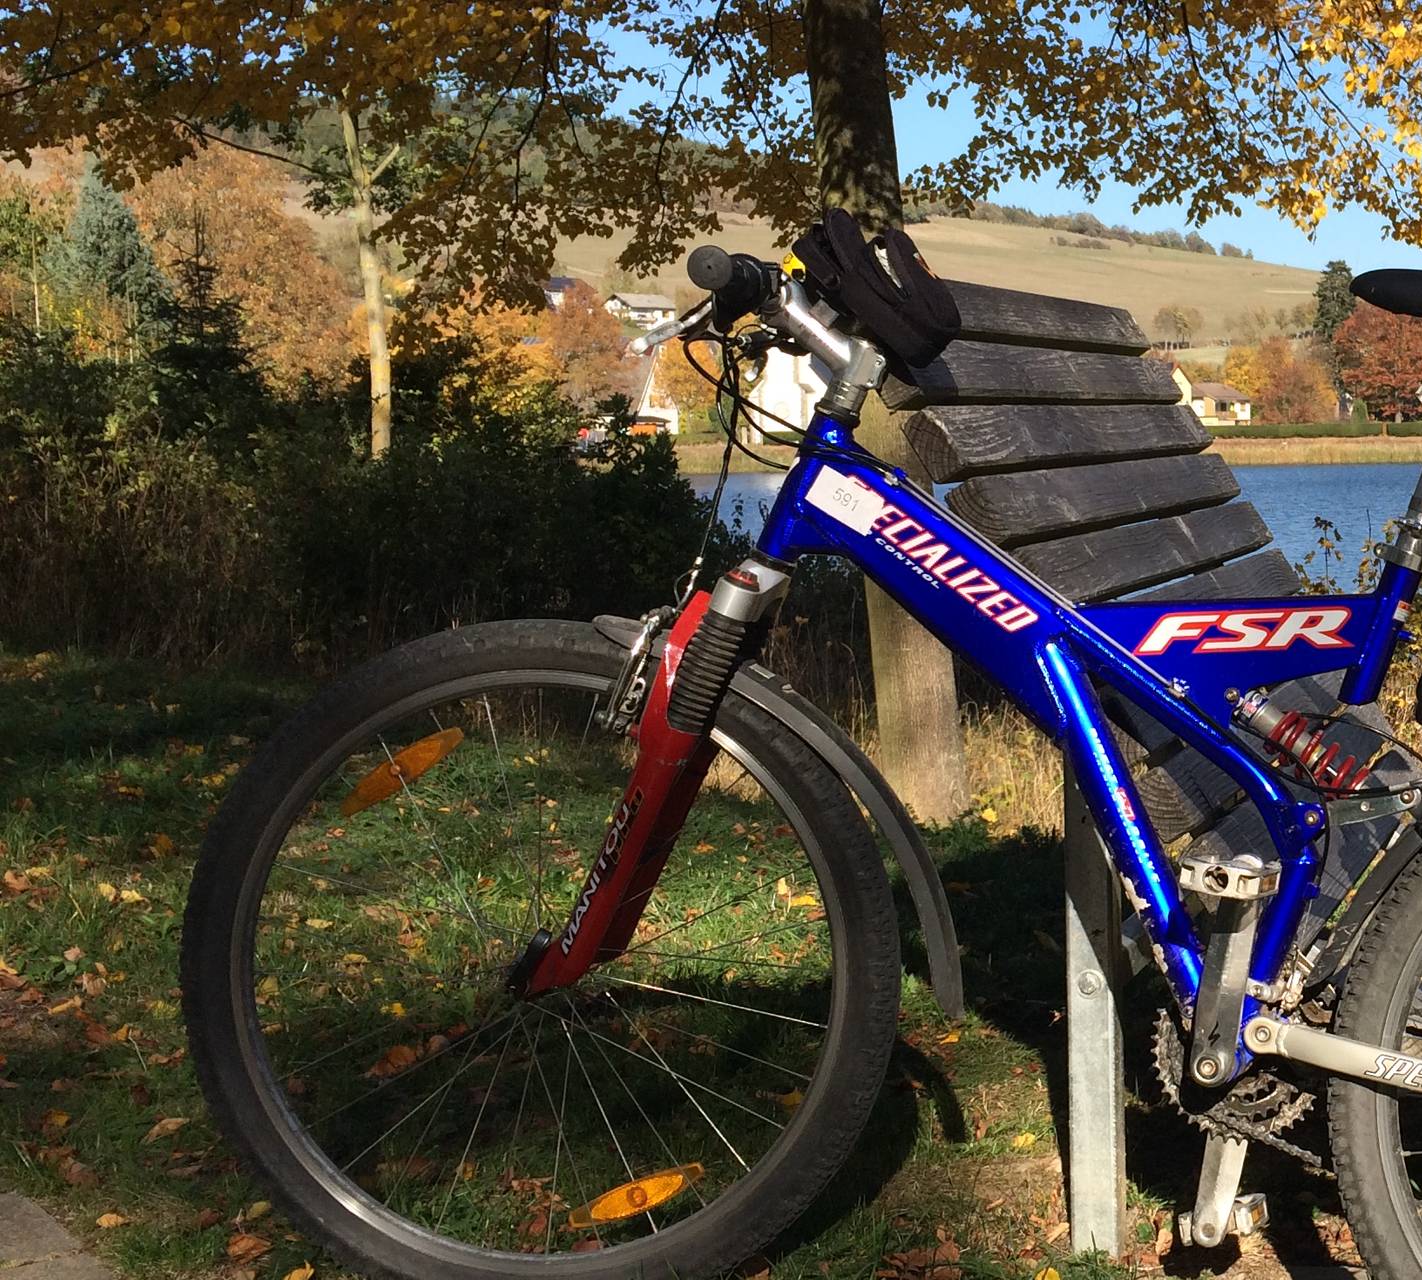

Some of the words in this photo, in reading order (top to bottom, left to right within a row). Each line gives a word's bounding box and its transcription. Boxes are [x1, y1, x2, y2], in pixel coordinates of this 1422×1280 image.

[832, 487, 862, 513] 591
[849, 474, 1039, 634] ECIALIZED
[876, 538, 940, 589] CONTROL
[1132, 605, 1356, 657] FSR
[560, 803, 630, 955] MANITOU
